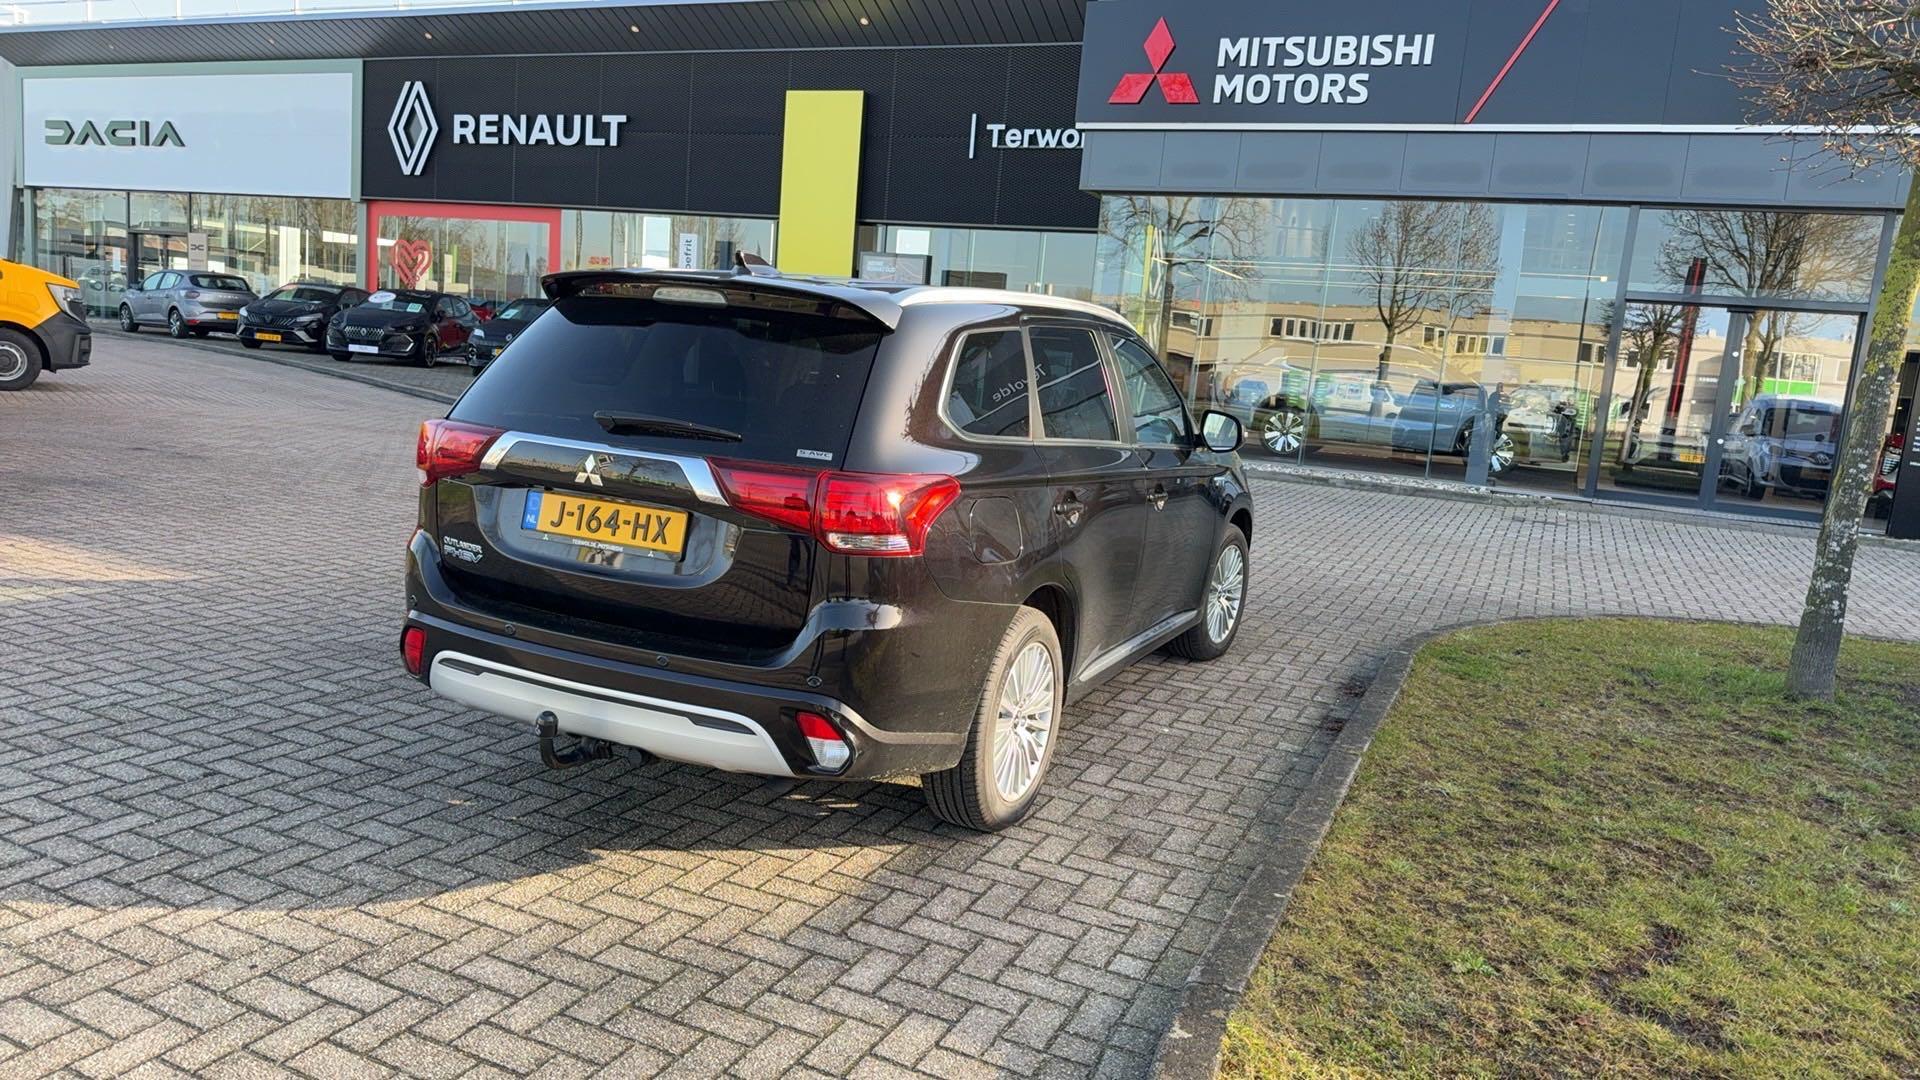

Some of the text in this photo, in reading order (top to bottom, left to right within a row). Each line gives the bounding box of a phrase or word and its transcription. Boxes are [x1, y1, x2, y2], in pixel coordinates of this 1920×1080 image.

[1217, 34, 1435, 67] MITSUBISHI
[1213, 73, 1369, 104] MOTORS
[45, 120, 186, 147] DACIA
[453, 114, 627, 146] RENAULT
[550, 501, 671, 545] J-164-HX
